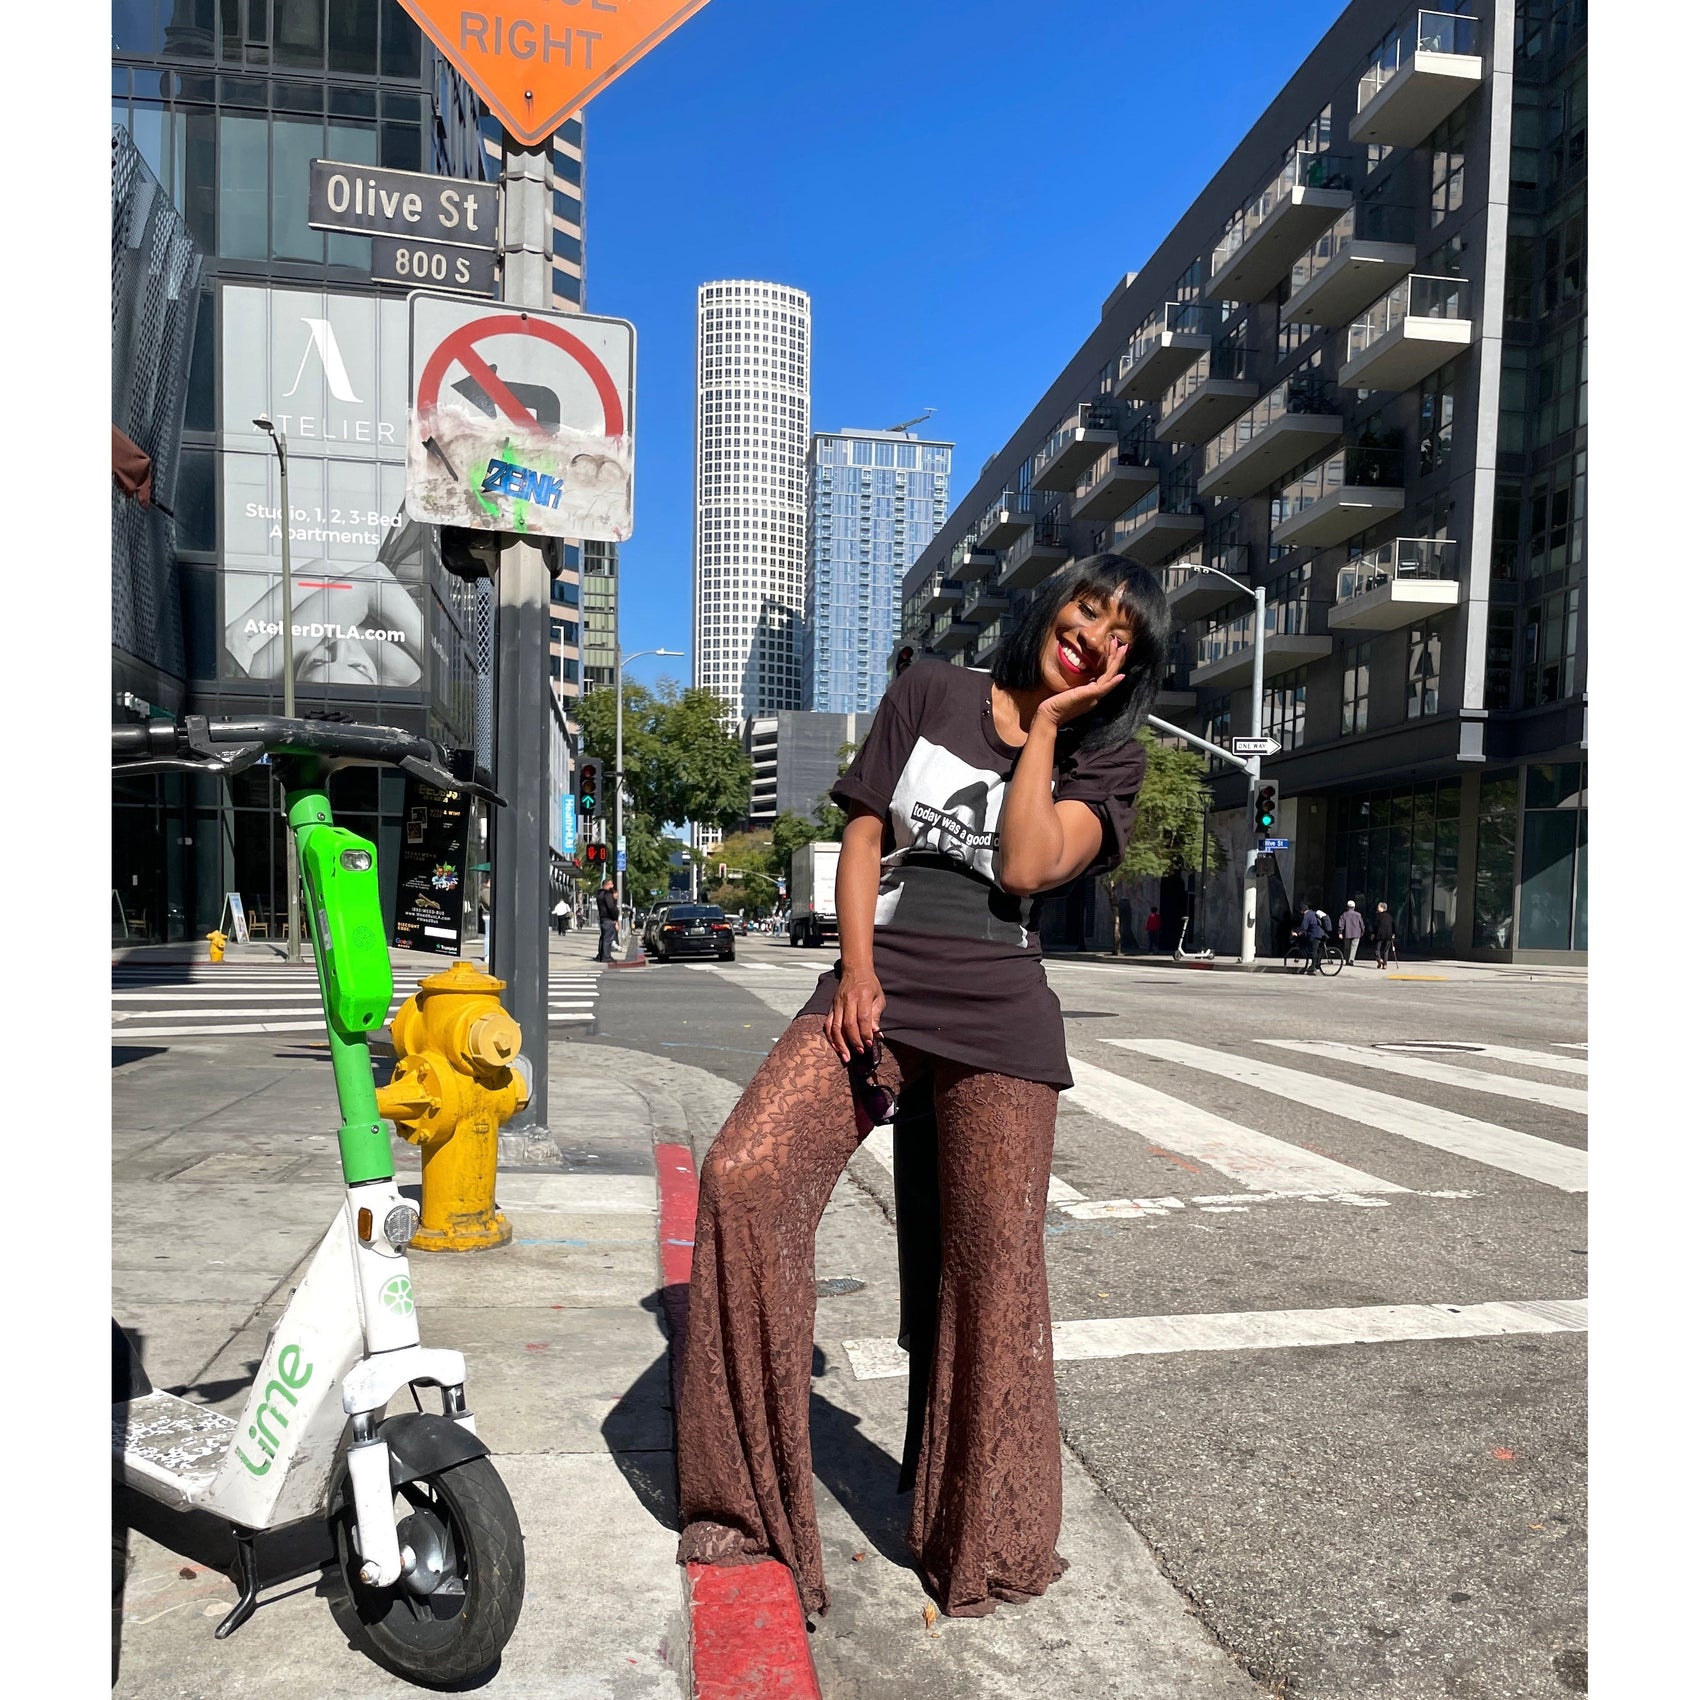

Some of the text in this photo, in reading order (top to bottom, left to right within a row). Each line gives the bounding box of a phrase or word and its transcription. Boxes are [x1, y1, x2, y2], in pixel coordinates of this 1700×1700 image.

[460, 11, 602, 70] RIGHT
[327, 174, 479, 231] Olive St
[395, 248, 470, 284] 800 S
[252, 414, 395, 443] TELIER
[314, 508, 326, 524] 1,
[330, 509, 346, 525] 2,
[350, 511, 402, 528] 3-Bed
[244, 619, 406, 642] AtelerDTLA.com
[913, 804, 941, 826] today
[941, 816, 960, 834] was
[960, 830, 967, 839] a
[966, 833, 992, 846] good
[234, 1344, 313, 1476] Lime
